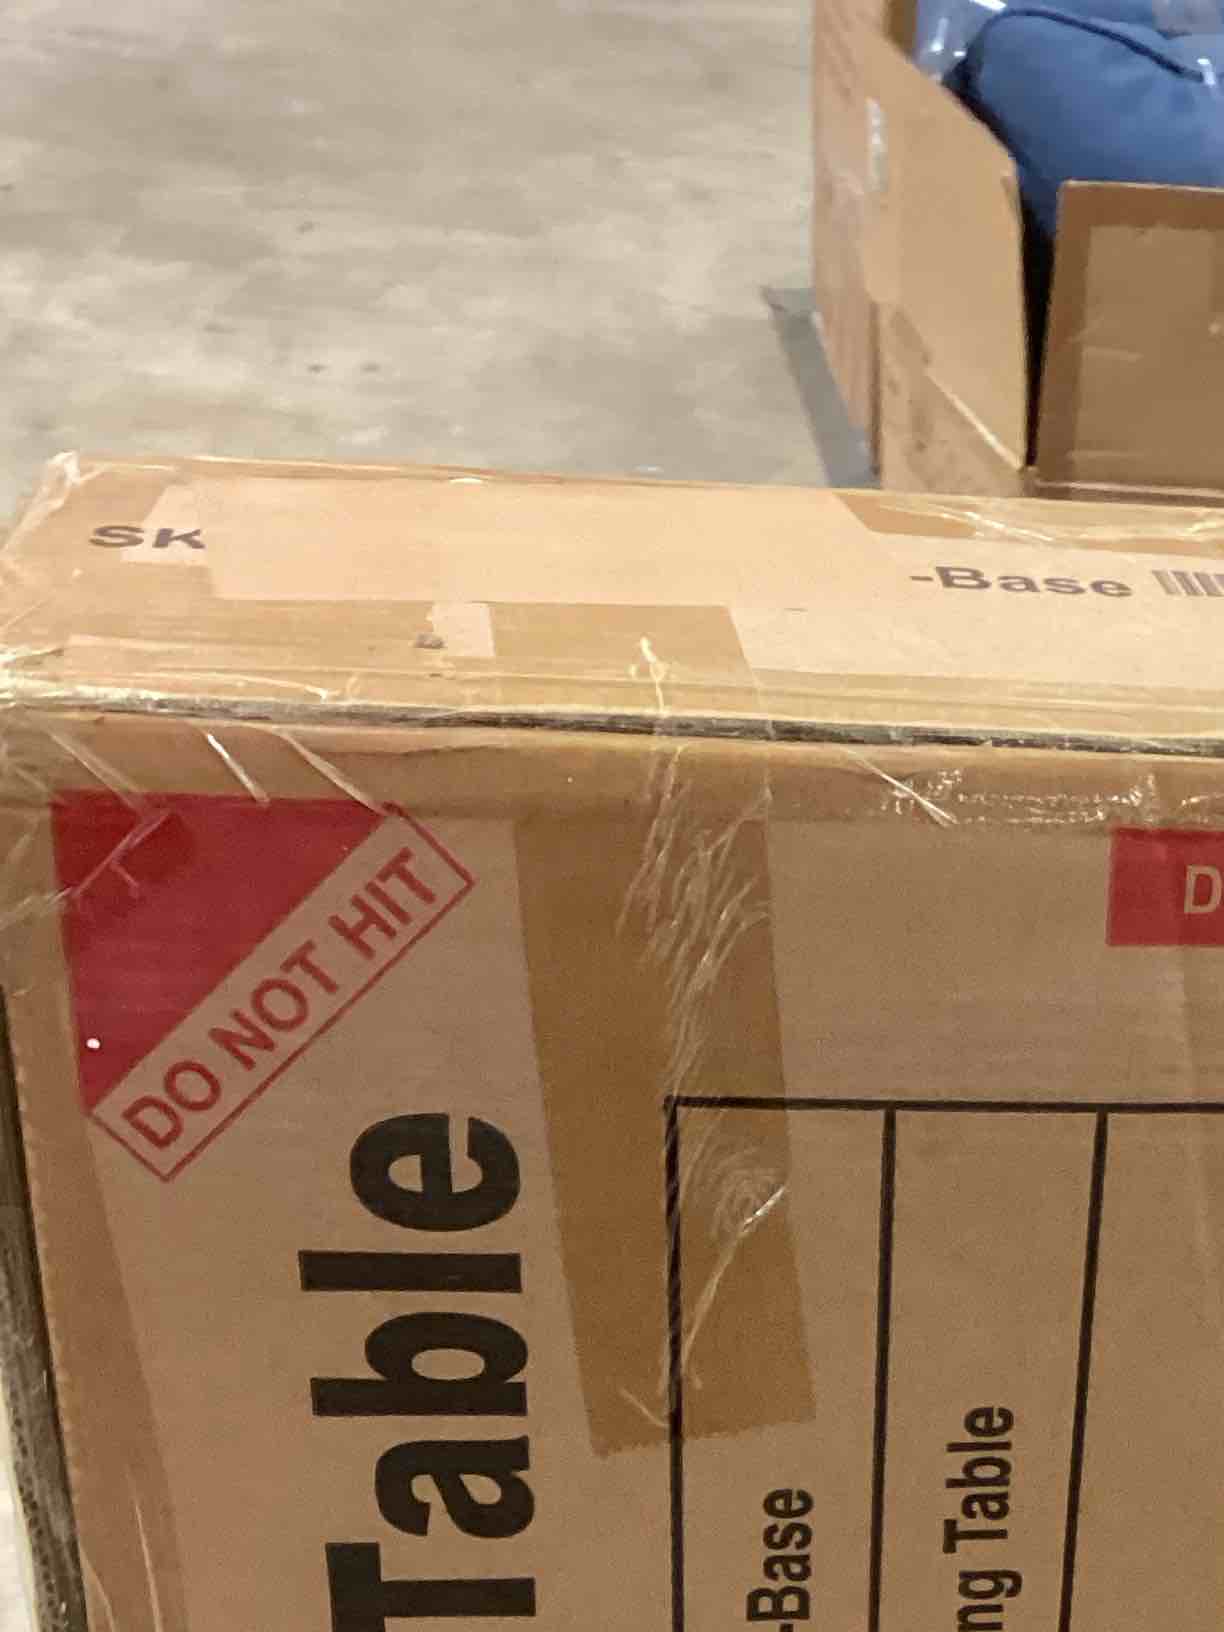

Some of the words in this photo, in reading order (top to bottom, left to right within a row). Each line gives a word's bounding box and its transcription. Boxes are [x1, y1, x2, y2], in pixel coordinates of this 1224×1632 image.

[911, 565, 1133, 597] -Base
[122, 1062, 222, 1152] DO
[210, 941, 343, 1071] NOT
[329, 848, 437, 960] HIT
[943, 1404, 1014, 1555] Table
